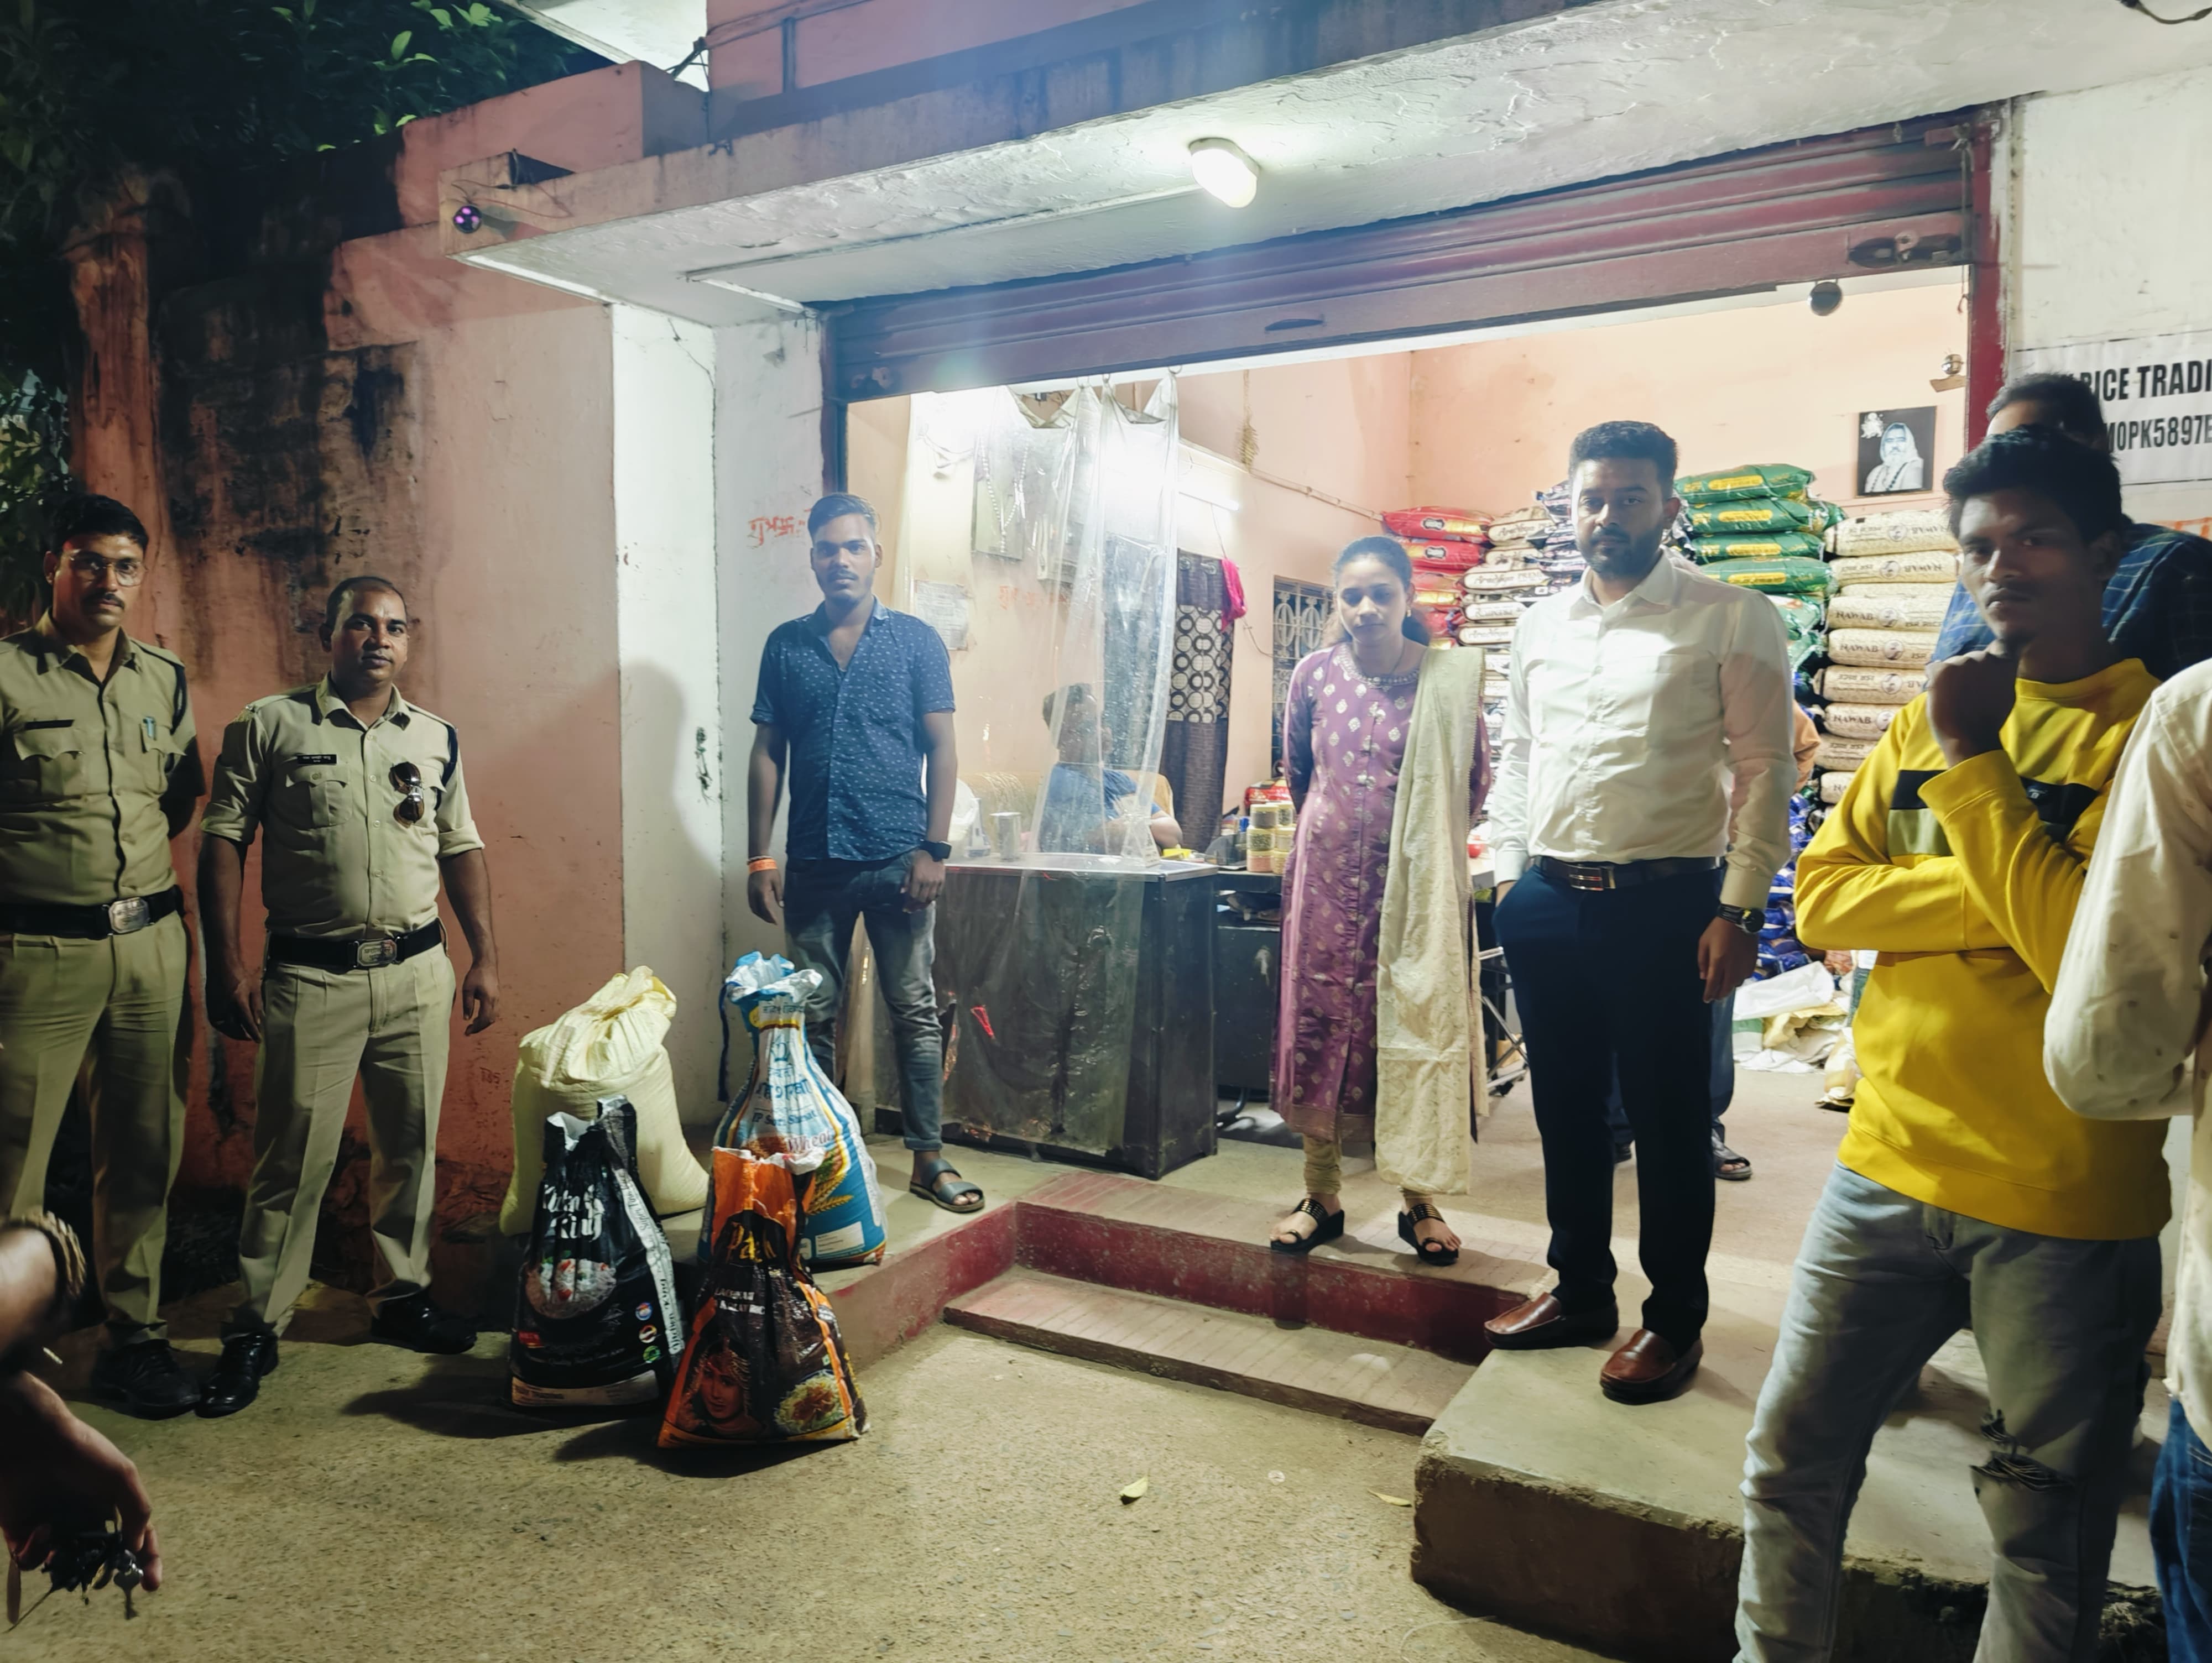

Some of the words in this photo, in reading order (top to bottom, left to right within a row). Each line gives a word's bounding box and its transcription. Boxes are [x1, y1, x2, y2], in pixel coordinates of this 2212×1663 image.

[1836, 611, 1874, 620] NAWAB
[1840, 644, 1879, 652] NAWAB
[1833, 715, 1872, 724] NAWAB
